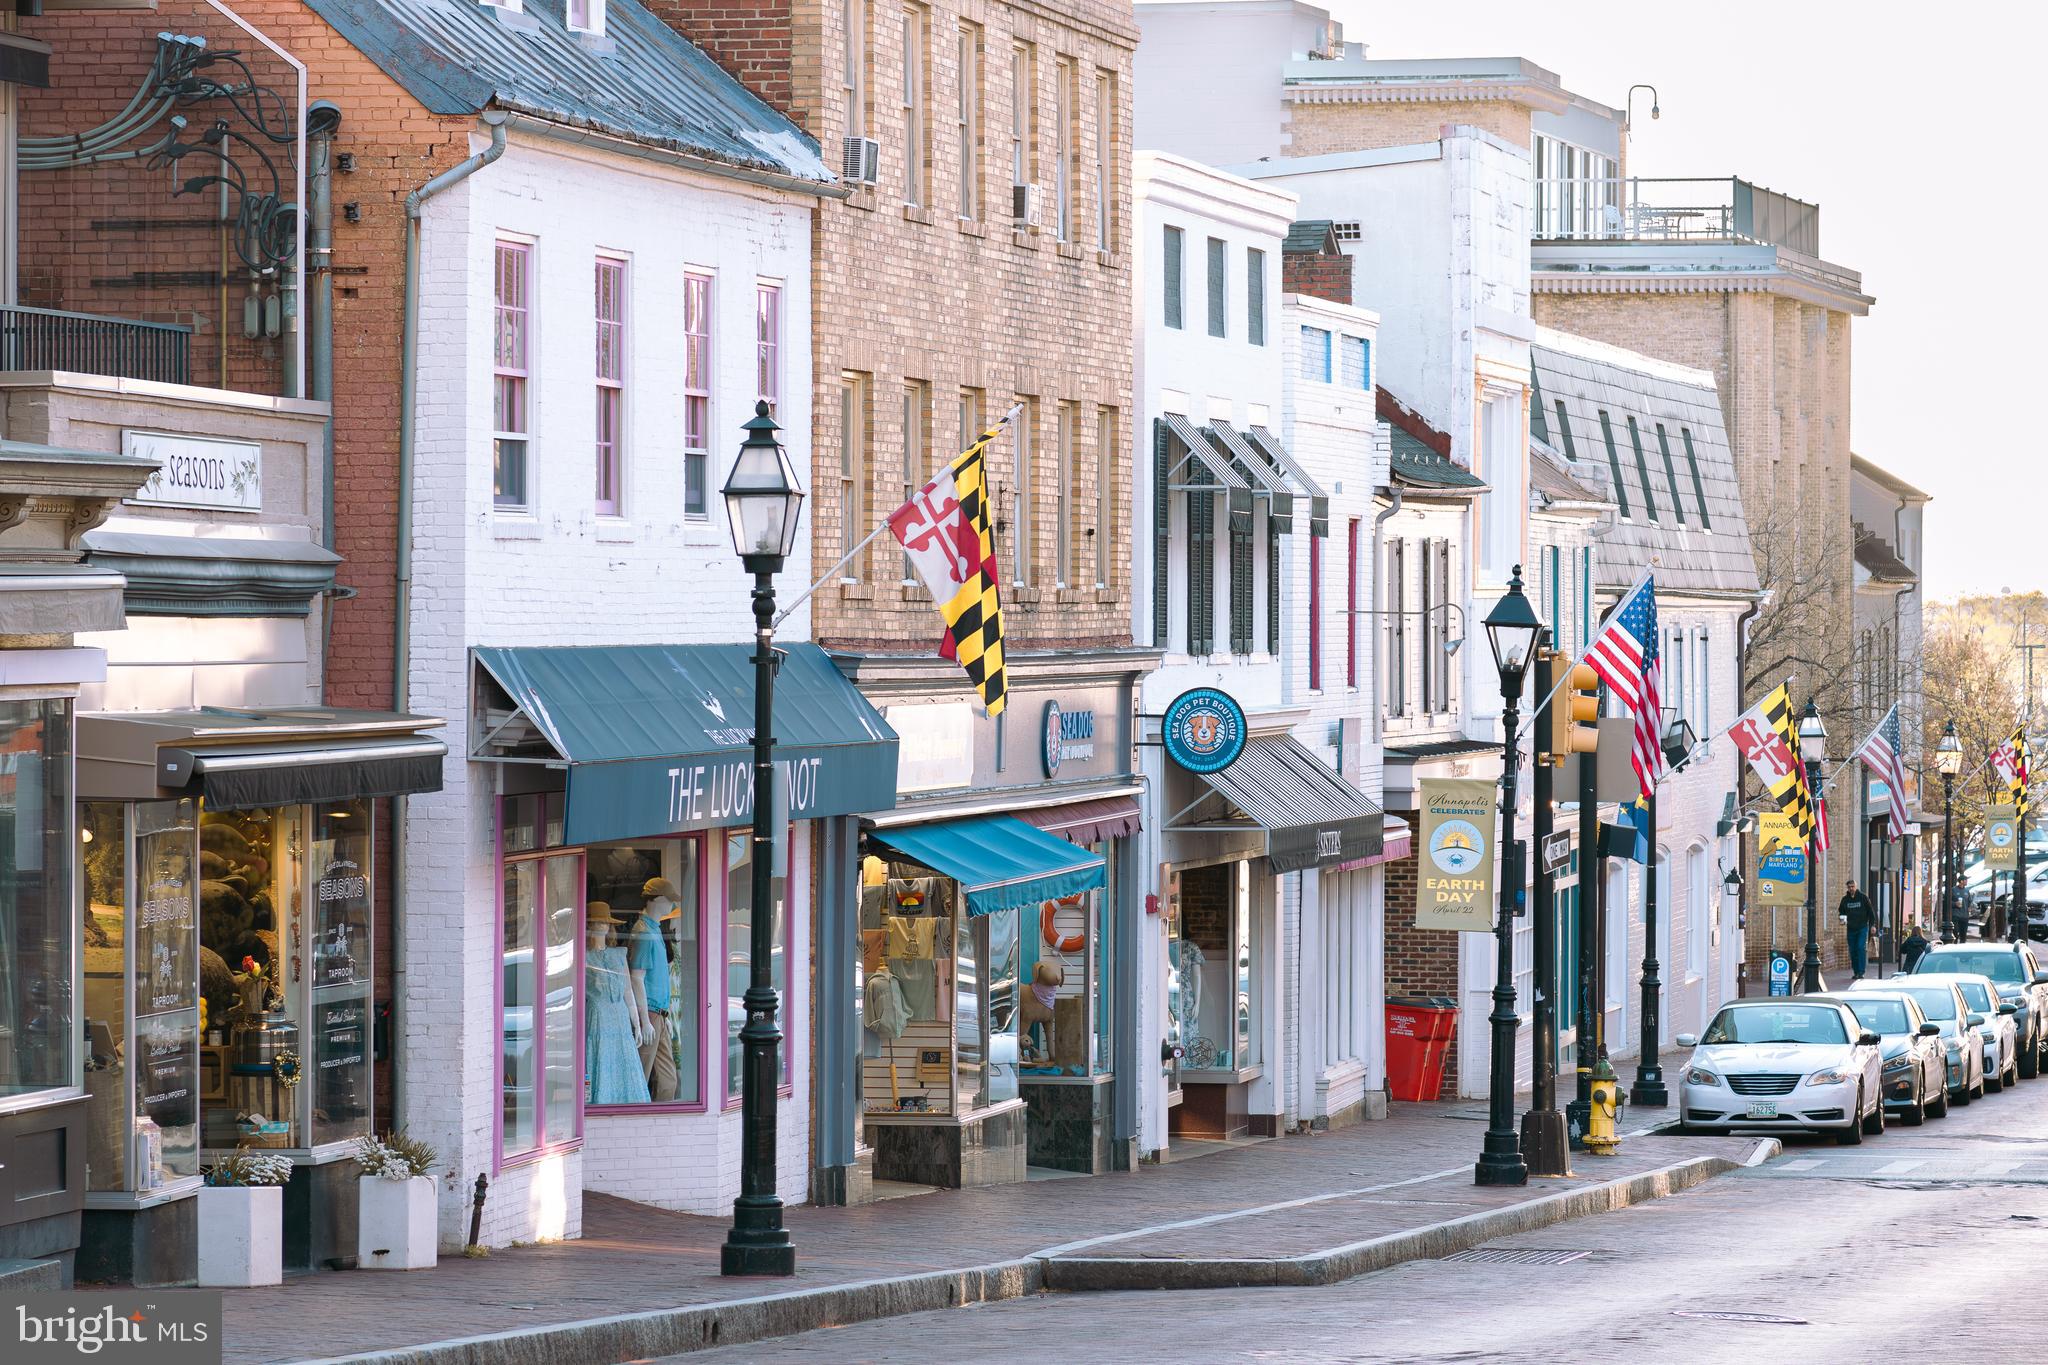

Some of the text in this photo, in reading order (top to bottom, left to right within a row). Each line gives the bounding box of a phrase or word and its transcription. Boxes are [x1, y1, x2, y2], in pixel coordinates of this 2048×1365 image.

[169, 454, 225, 490] seasons
[1171, 697, 1237, 741] SEA DOG PET BOUTIQUE
[668, 757, 821, 822] THE LUCK NOT
[1427, 792, 1489, 808] Annapolis
[1430, 807, 1486, 816] CELEBRATES
[320, 877, 364, 900] SEASONS
[1426, 878, 1485, 891] EARTH
[1436, 891, 1474, 903] DAY
[143, 896, 189, 923] SEASONS
[1433, 904, 1474, 914] April 22
[328, 967, 354, 978] TAPROOM
[152, 994, 179, 1006] TAPROOM
[330, 1034, 351, 1042] PREMIUM
[144, 1093, 165, 1104] PRODUCER
